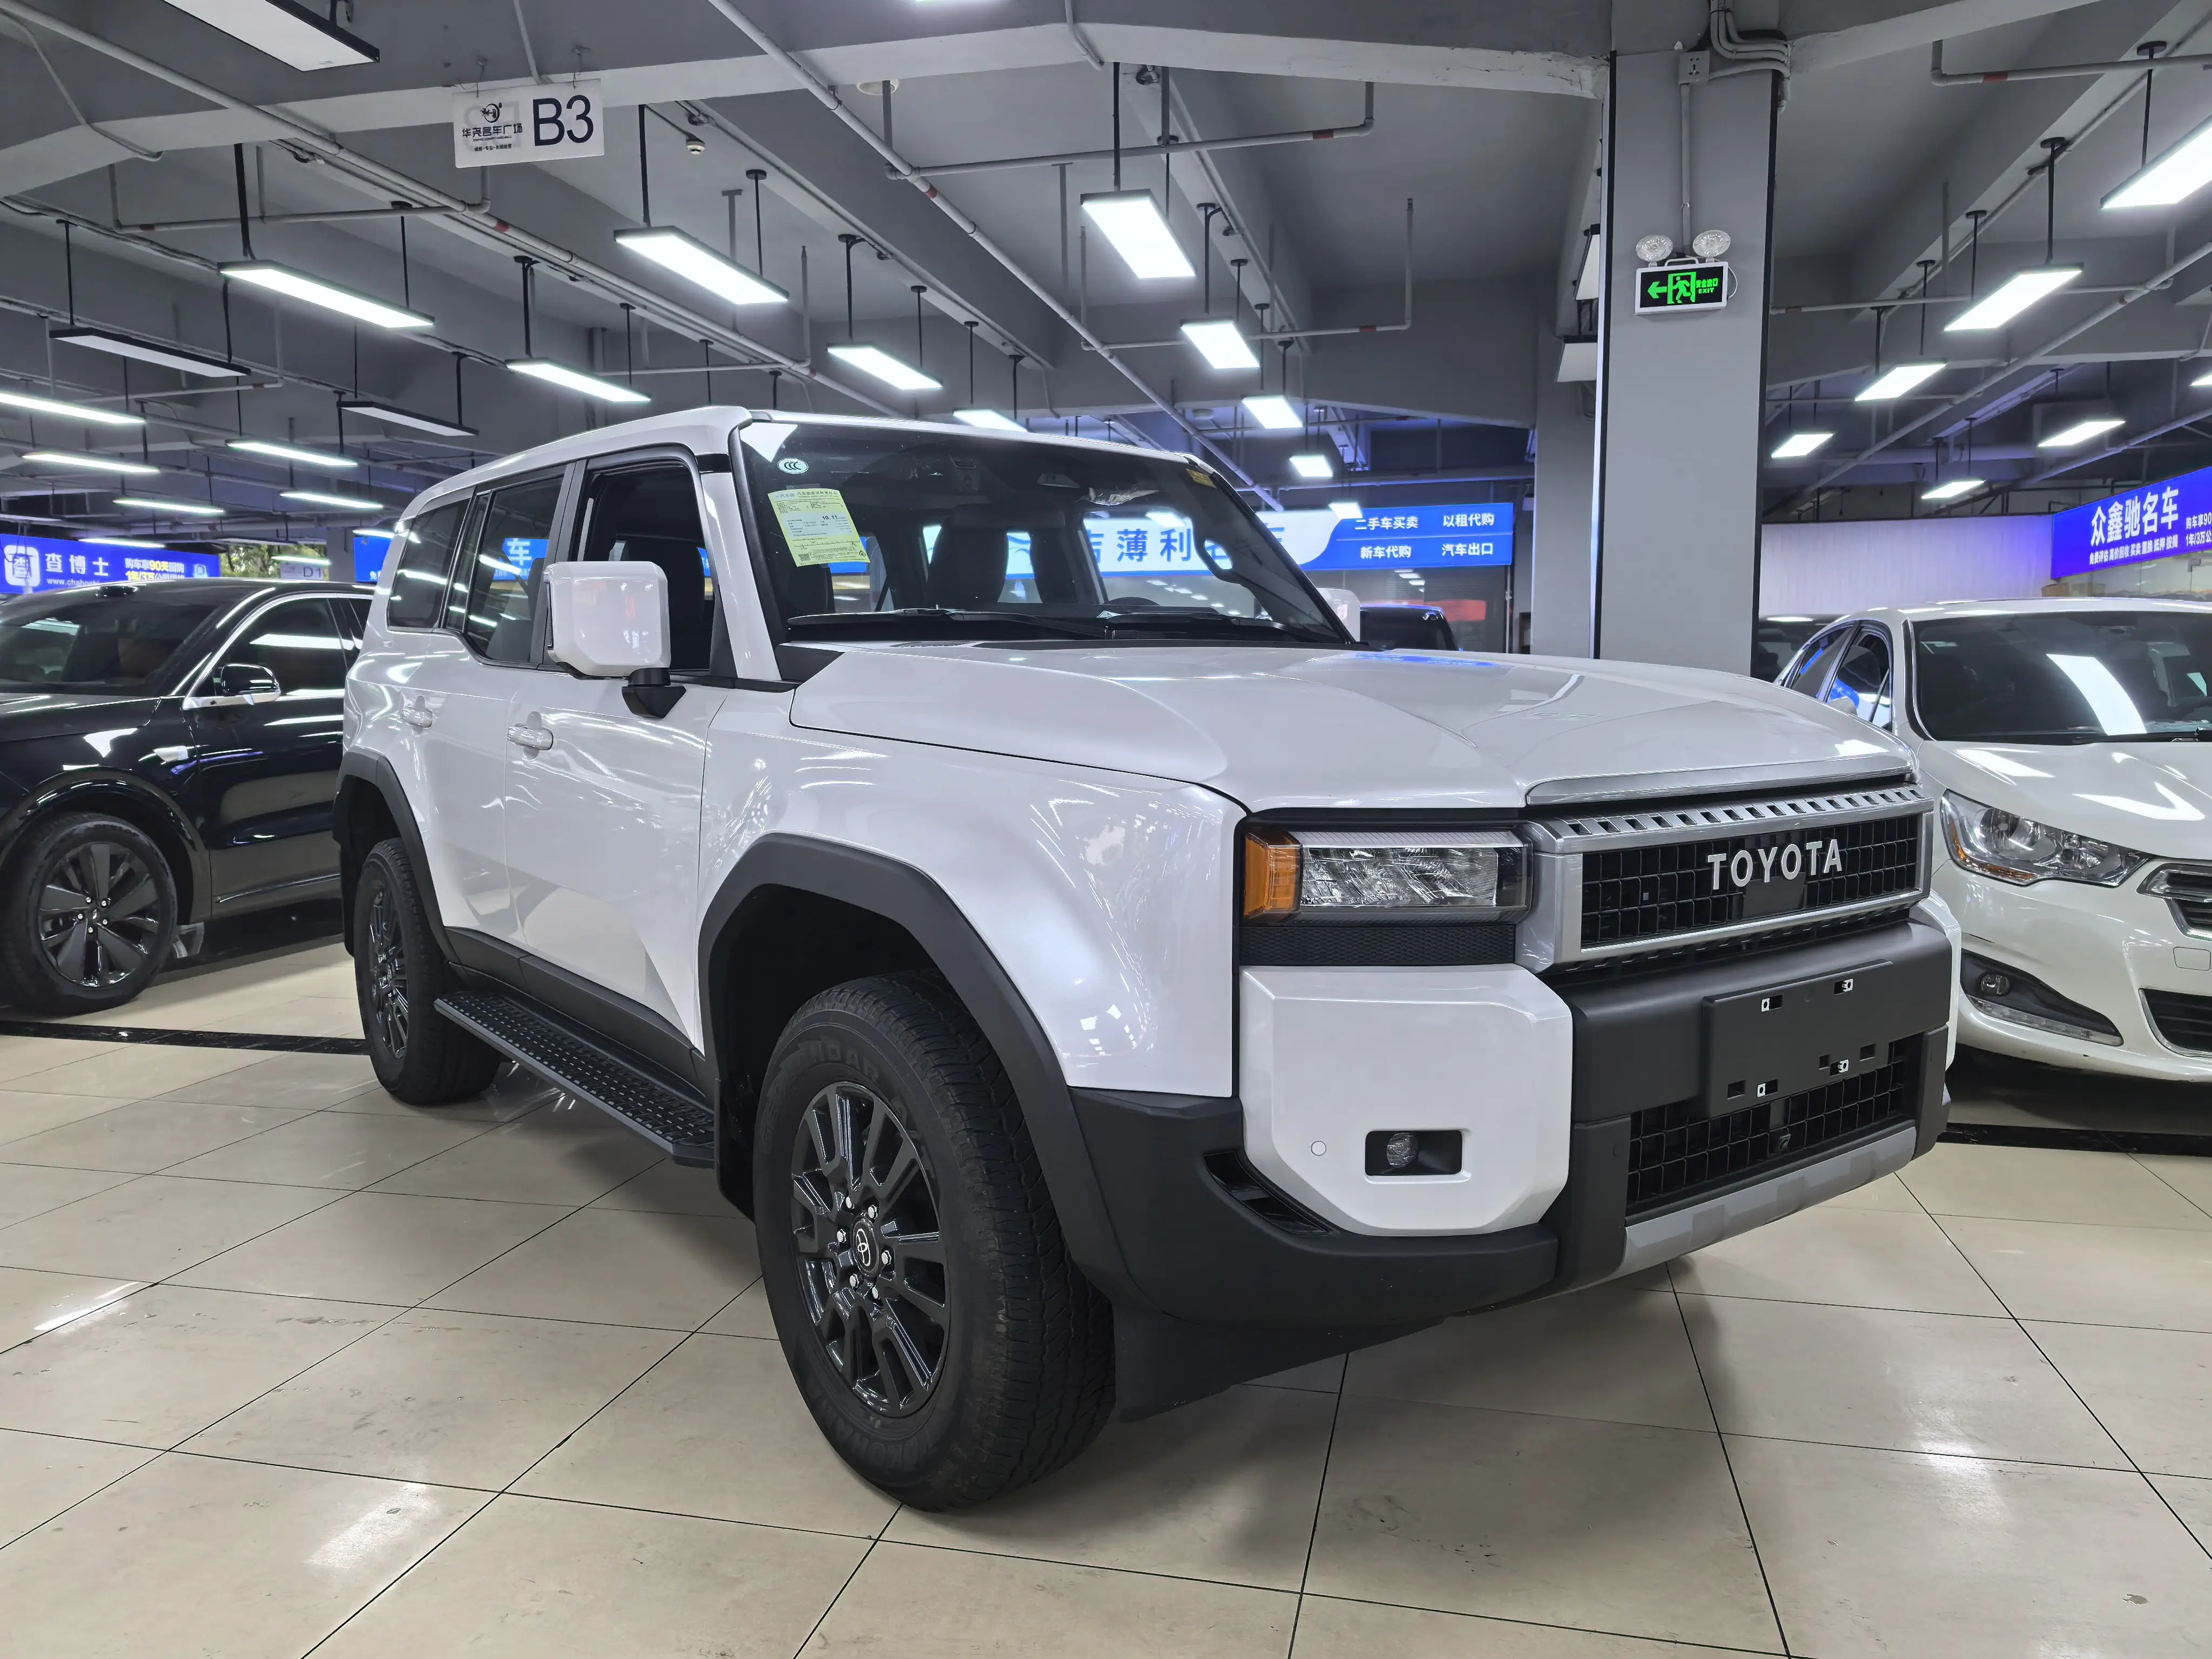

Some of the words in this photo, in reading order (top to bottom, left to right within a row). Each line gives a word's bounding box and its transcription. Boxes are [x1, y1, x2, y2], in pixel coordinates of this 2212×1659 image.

[532, 95, 594, 146] B3
[1354, 516, 1419, 530] 二手车买卖
[1442, 513, 1495, 527] 以租代购
[2090, 486, 2179, 547] 众鑫驰名车
[2186, 529, 2212, 546] 1年/3万公
[1360, 545, 1412, 559] 新车代购
[1441, 543, 1493, 556] 汽车出口
[2089, 549, 2109, 565] 免费评估
[2109, 545, 2130, 561] 高价回收
[45, 553, 109, 576] 查博士
[303, 567, 321, 578] D1
[1708, 839, 1842, 890] TOYOTA
